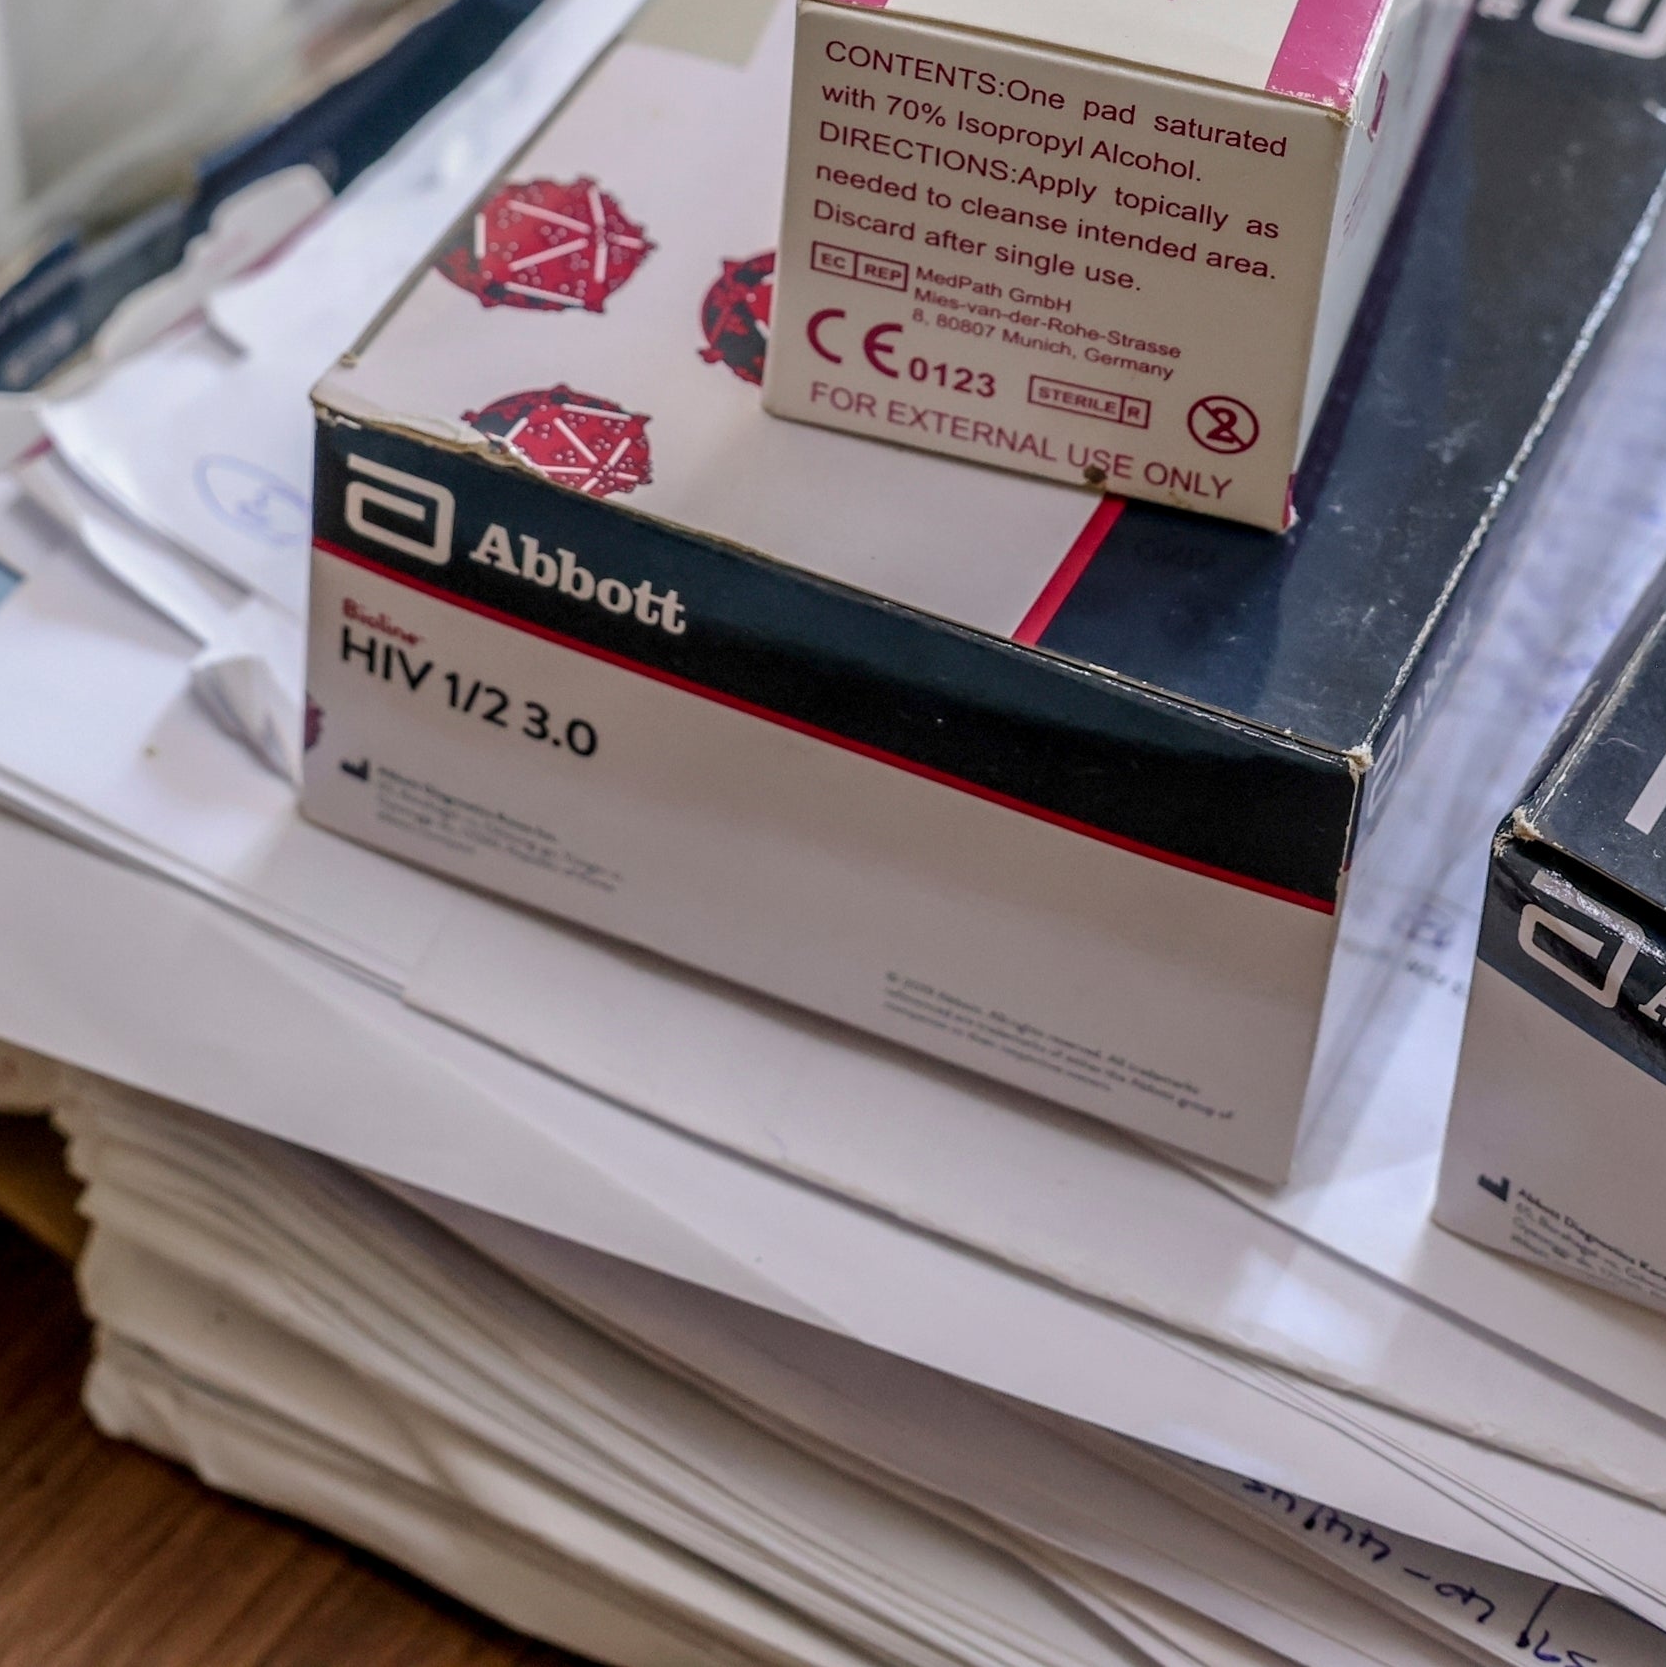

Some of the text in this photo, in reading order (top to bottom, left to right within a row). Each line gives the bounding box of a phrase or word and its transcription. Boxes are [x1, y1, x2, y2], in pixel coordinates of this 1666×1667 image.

[821, 85, 1201, 182] with 70% Isopropyl Alcohol.
[1083, 100, 1136, 126] pad
[1153, 115, 1287, 158] saturated
[813, 198, 1141, 292] Discard after single use.
[816, 164, 1276, 280] needed to cleanse intended area.
[1114, 186, 1229, 233] topically
[1245, 219, 1279, 239] as
[815, 252, 908, 286] EC REP
[915, 265, 1072, 314] MedPath GmbH
[914, 286, 1182, 360] Mies-van-der-Rohe-Strasse
[935, 313, 997, 338] 80807
[1001, 328, 1076, 359] Munich,
[1084, 347, 1175, 382] Germany
[908, 356, 996, 398] 0123
[1039, 386, 1122, 415] STERILE
[810, 380, 1233, 500] FOR EXTERNAL USE ONLY
[469, 523, 686, 635] Abbott
[341, 625, 598, 758] HIV 1/2 3.0
